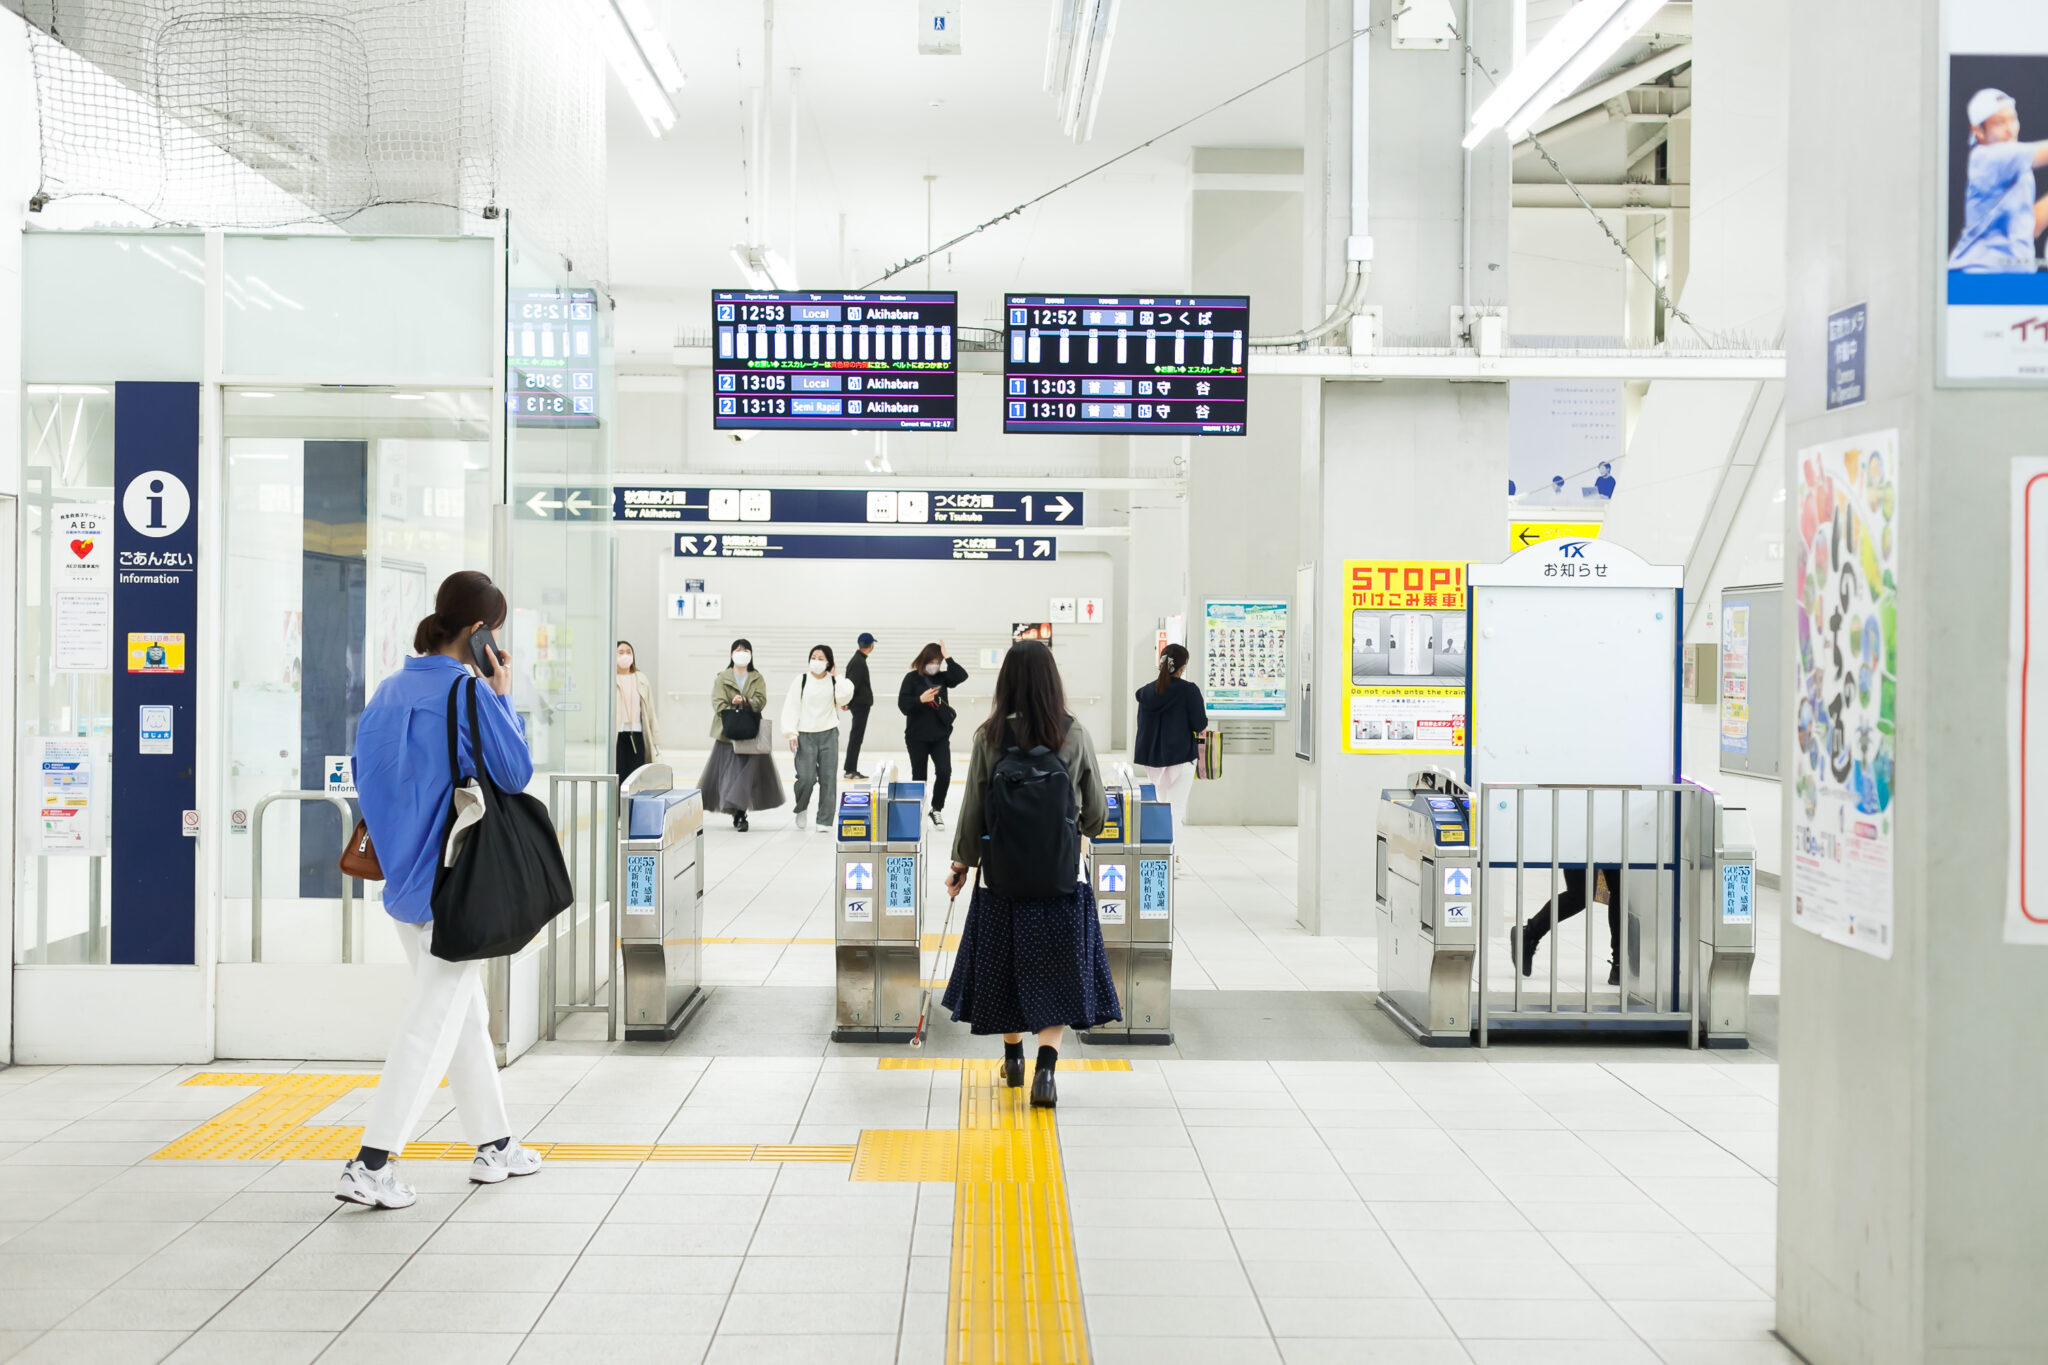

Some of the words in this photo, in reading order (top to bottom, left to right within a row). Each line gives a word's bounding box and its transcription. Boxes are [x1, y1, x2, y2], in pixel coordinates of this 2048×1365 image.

[721, 307, 732, 320] 2
[740, 306, 785, 321] 12:53
[803, 308, 829, 320] Local
[867, 308, 919, 320] Akihabara
[1033, 310, 1077, 325] 12:52
[1158, 311, 1213, 326] つくば
[722, 376, 732, 389] 2
[742, 376, 786, 390] 13:05
[803, 378, 829, 389] Local
[867, 378, 919, 390] Akihabara
[1032, 380, 1076, 394] 13:03
[1156, 381, 1210, 396] 守谷
[722, 400, 732, 413] 2
[742, 399, 786, 414] 13:13
[793, 402, 814, 412] Semi
[816, 402, 841, 414] Rapid
[867, 402, 919, 413] Akihabara
[1032, 404, 1076, 418] 13:10
[1156, 405, 1210, 418] 守谷
[625, 510, 638, 518] for
[640, 509, 681, 518] Akihabara
[1020, 496, 1032, 522] 1
[934, 512, 947, 521] for
[949, 512, 983, 522] Tsukuba
[702, 536, 717, 556] 2
[1015, 538, 1025, 559] 1
[1559, 542, 1593, 558] TX
[120, 552, 193, 566] ごあんない
[1544, 563, 1608, 578] お知らせ
[120, 573, 180, 584] Information
[1352, 568, 1461, 592] STOP!
[1352, 592, 1464, 608] かけこみ乗車!
[329, 784, 358, 792] Inform
[848, 900, 868, 911] TX
[1102, 903, 1121, 914] TX
[1448, 906, 1468, 916] TX
[855, 1012, 860, 1020] 1
[894, 1012, 900, 1020] 2
[1449, 1017, 1455, 1025] 3
[1724, 1018, 1730, 1026] 4
